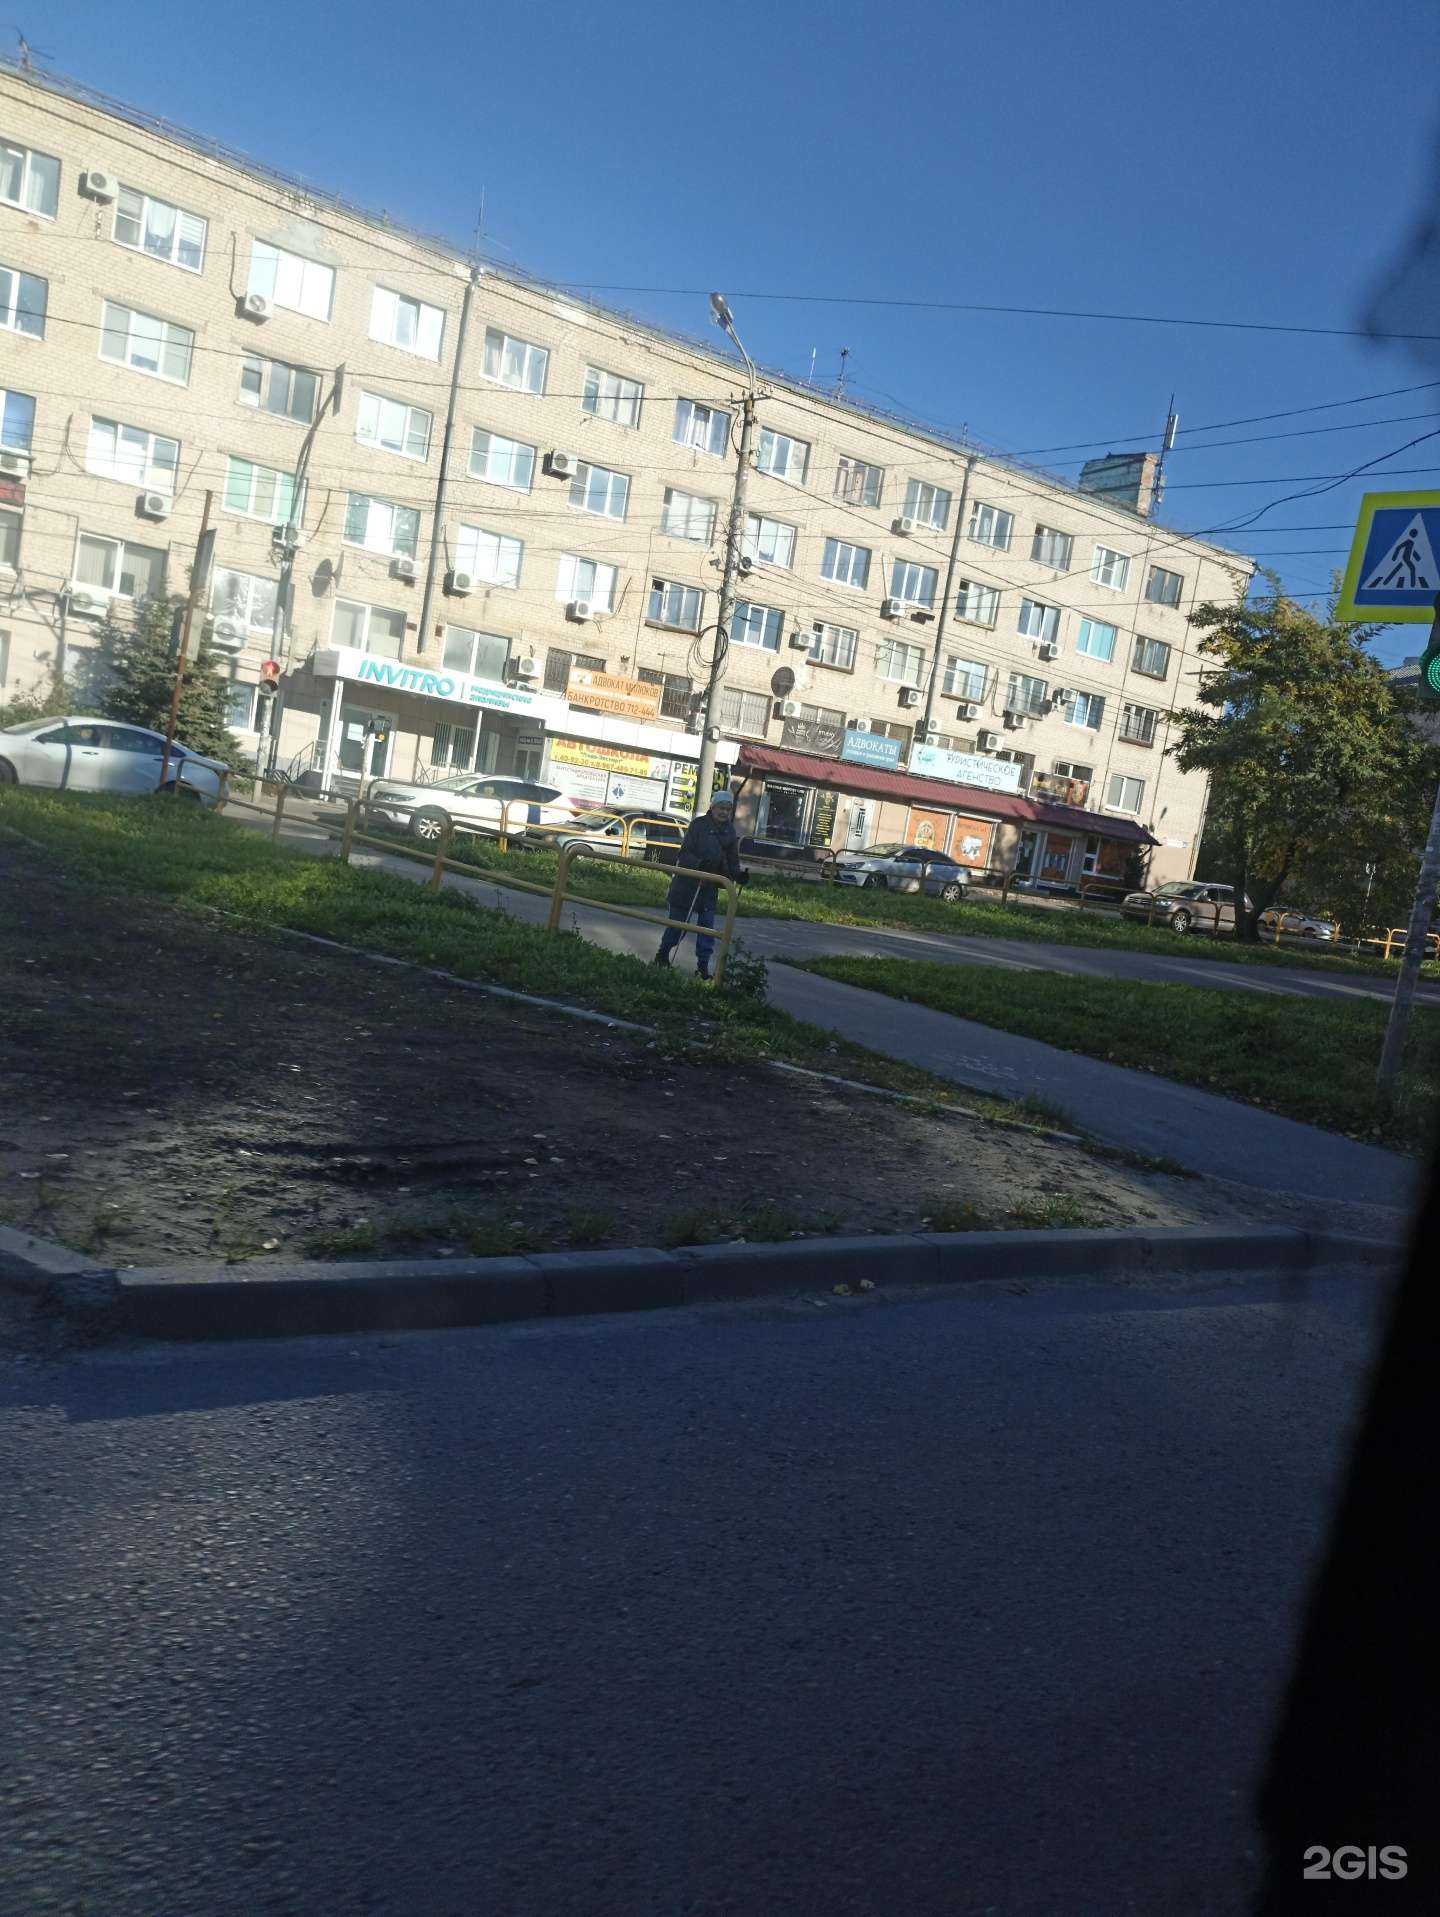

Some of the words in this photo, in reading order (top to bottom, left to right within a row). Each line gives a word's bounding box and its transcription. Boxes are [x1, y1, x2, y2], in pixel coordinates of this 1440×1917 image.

[357, 659, 456, 697] INVITRO
[592, 675, 625, 690] АДВОКАТ
[567, 691, 625, 711] БАНКРОТСТВО
[627, 703, 655, 717] 712-444
[846, 736, 897, 756] АДВОКАТЫ
[946, 753, 1017, 777] ТУРИСТИЧЕСКОЕ
